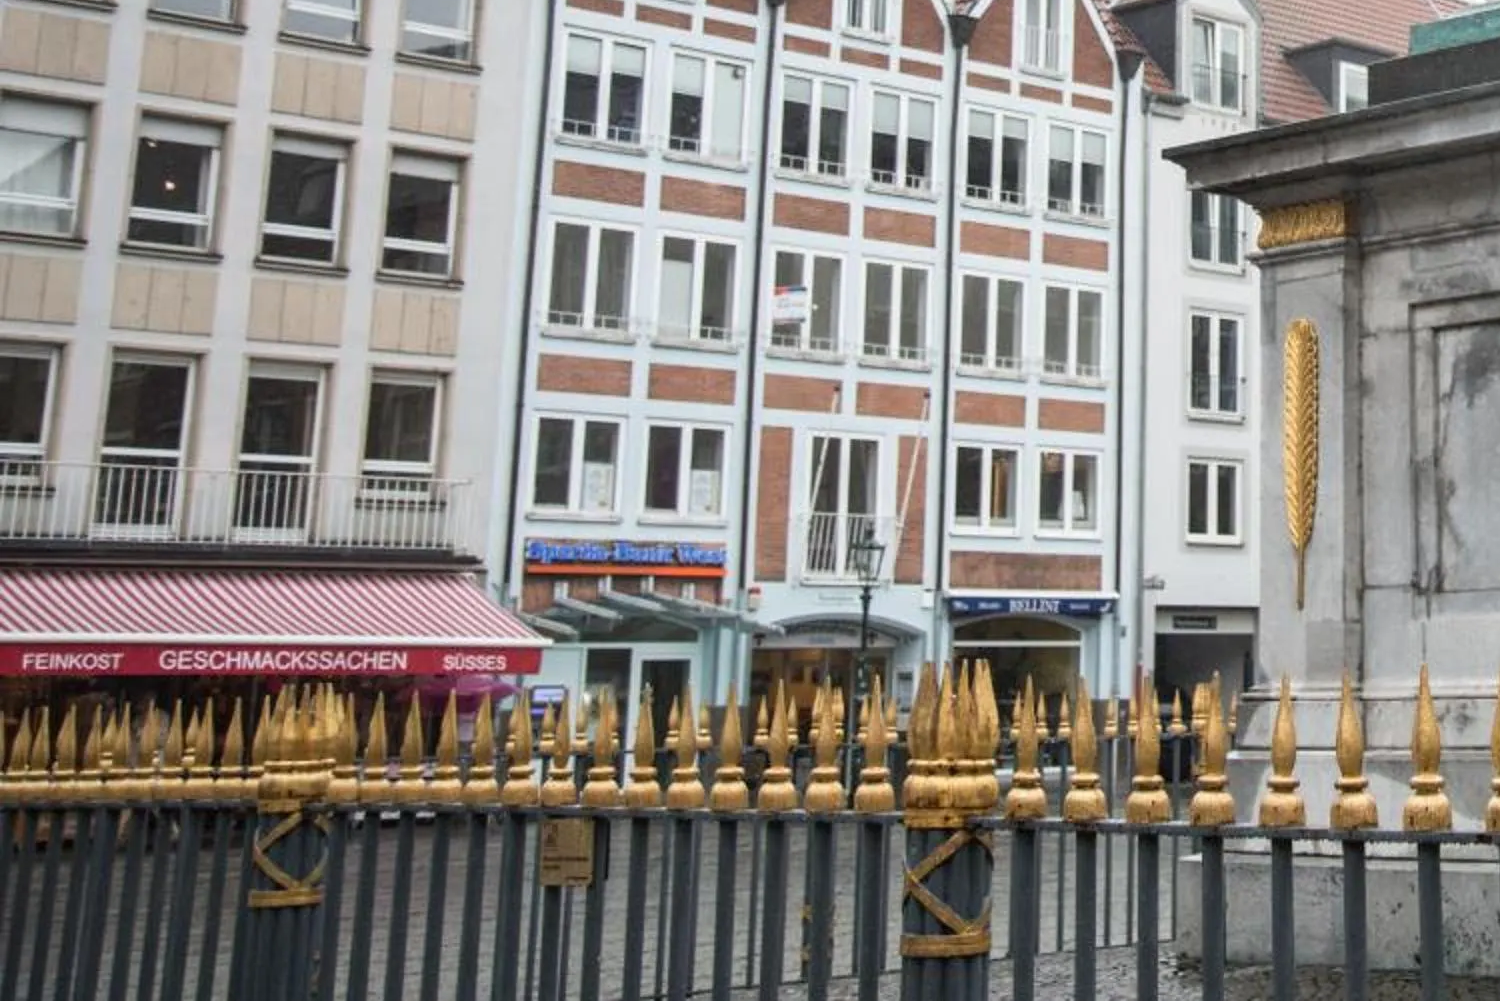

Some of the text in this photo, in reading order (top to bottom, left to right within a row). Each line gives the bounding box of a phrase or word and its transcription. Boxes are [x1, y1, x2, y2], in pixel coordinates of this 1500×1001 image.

[22, 651, 507, 671] FEINKOST GESCHMACKSSACHEN SÜSSES
